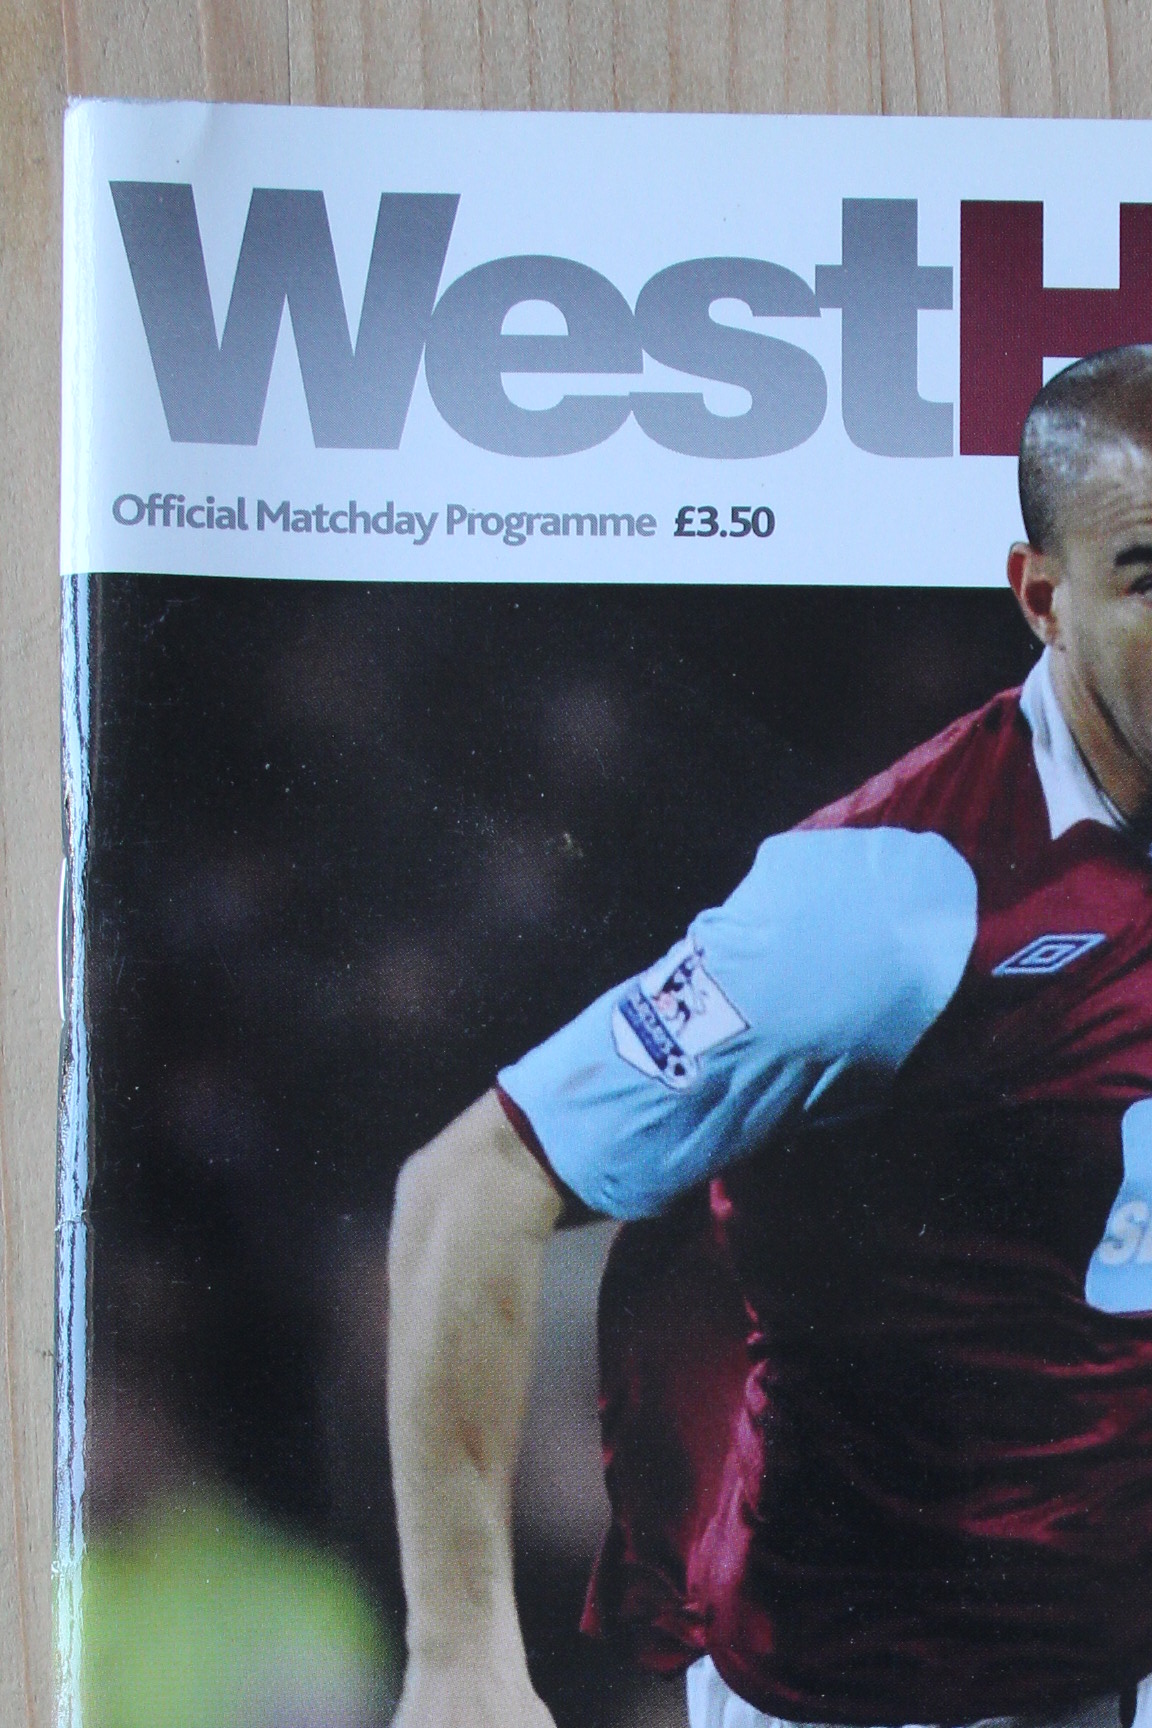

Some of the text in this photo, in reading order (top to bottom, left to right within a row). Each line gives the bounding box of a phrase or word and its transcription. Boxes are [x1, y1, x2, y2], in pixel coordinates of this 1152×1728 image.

[112, 492, 776, 547] Official Matchday Programme £3.50
